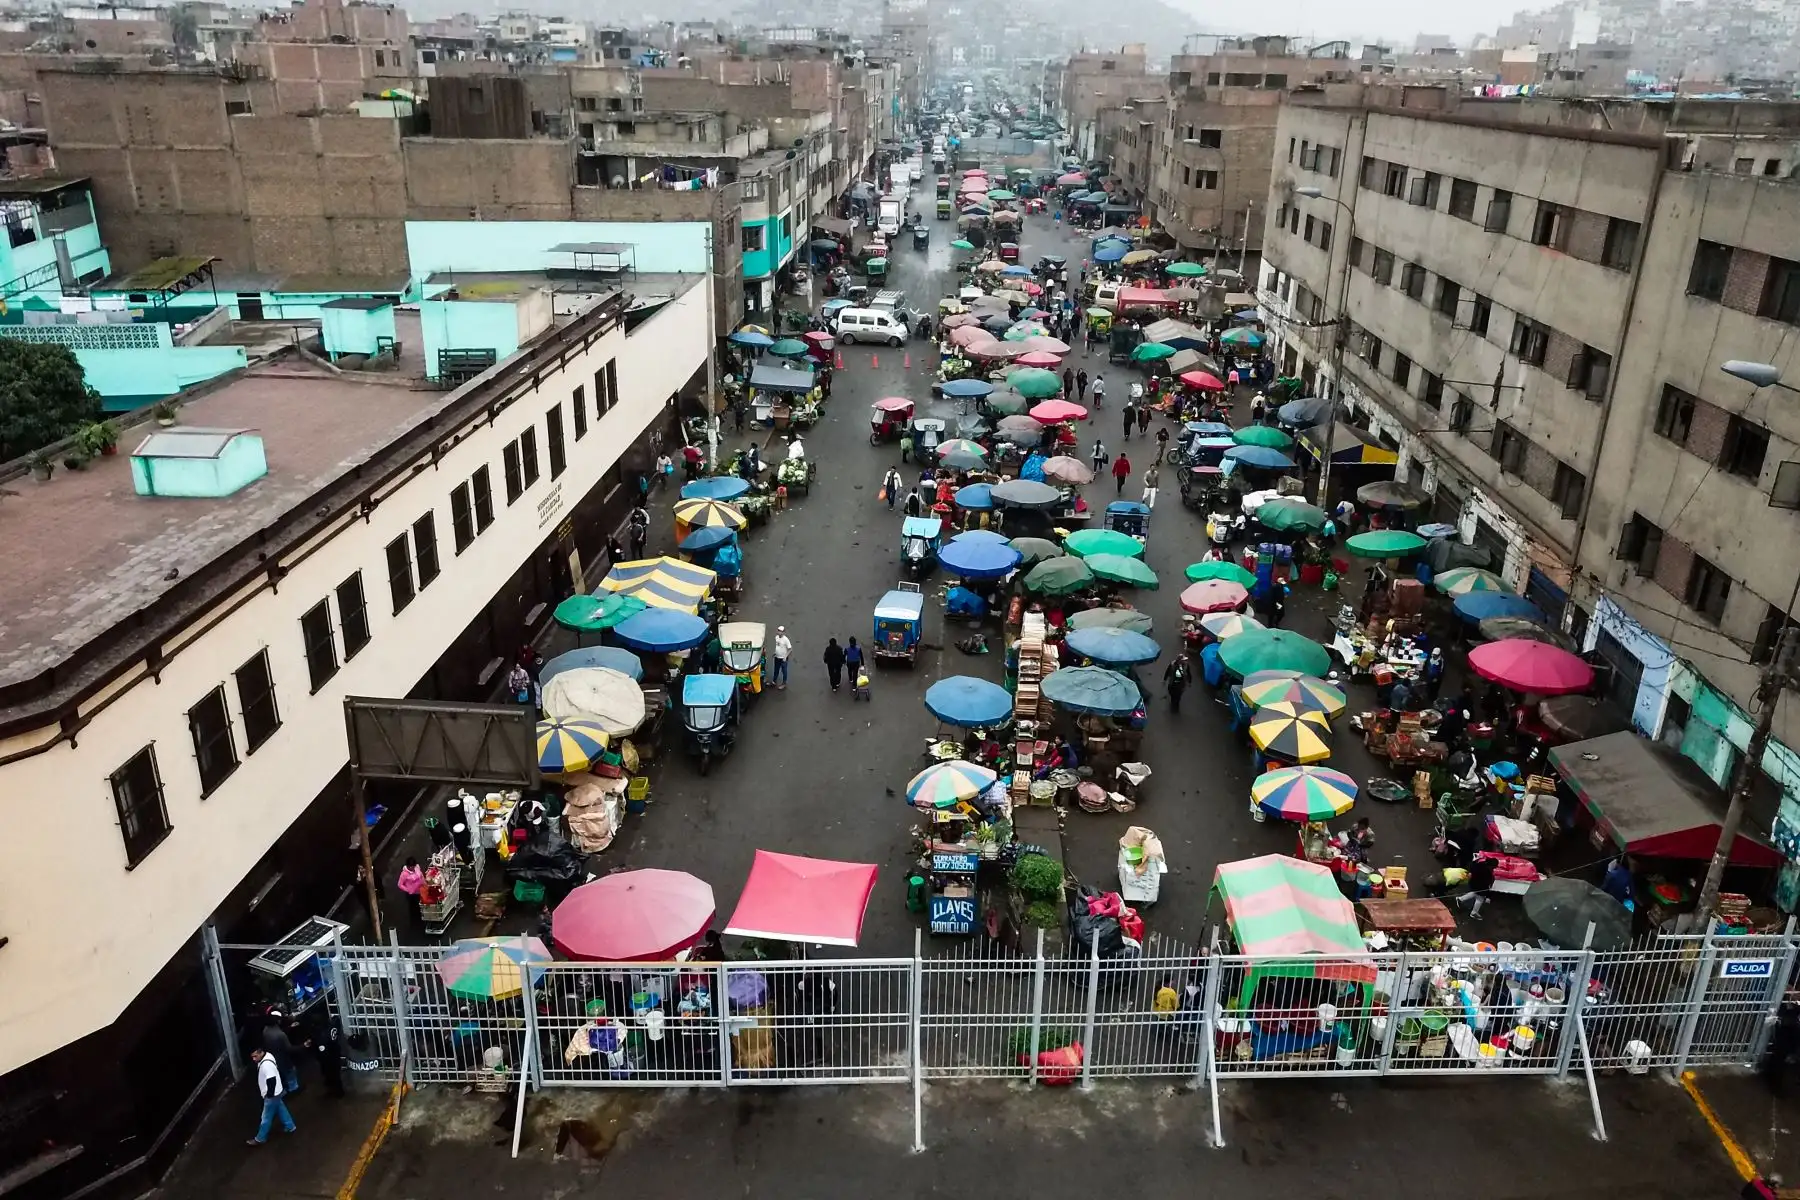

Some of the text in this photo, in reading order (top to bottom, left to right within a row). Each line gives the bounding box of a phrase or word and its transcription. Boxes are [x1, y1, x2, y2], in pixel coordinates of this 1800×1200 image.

[951, 862, 974, 870] JOSEPH
[933, 899, 974, 922] LLAVES
[950, 914, 957, 922] A
[931, 921, 969, 934] DOMICILIO
[1730, 964, 1766, 973] SALIDA
